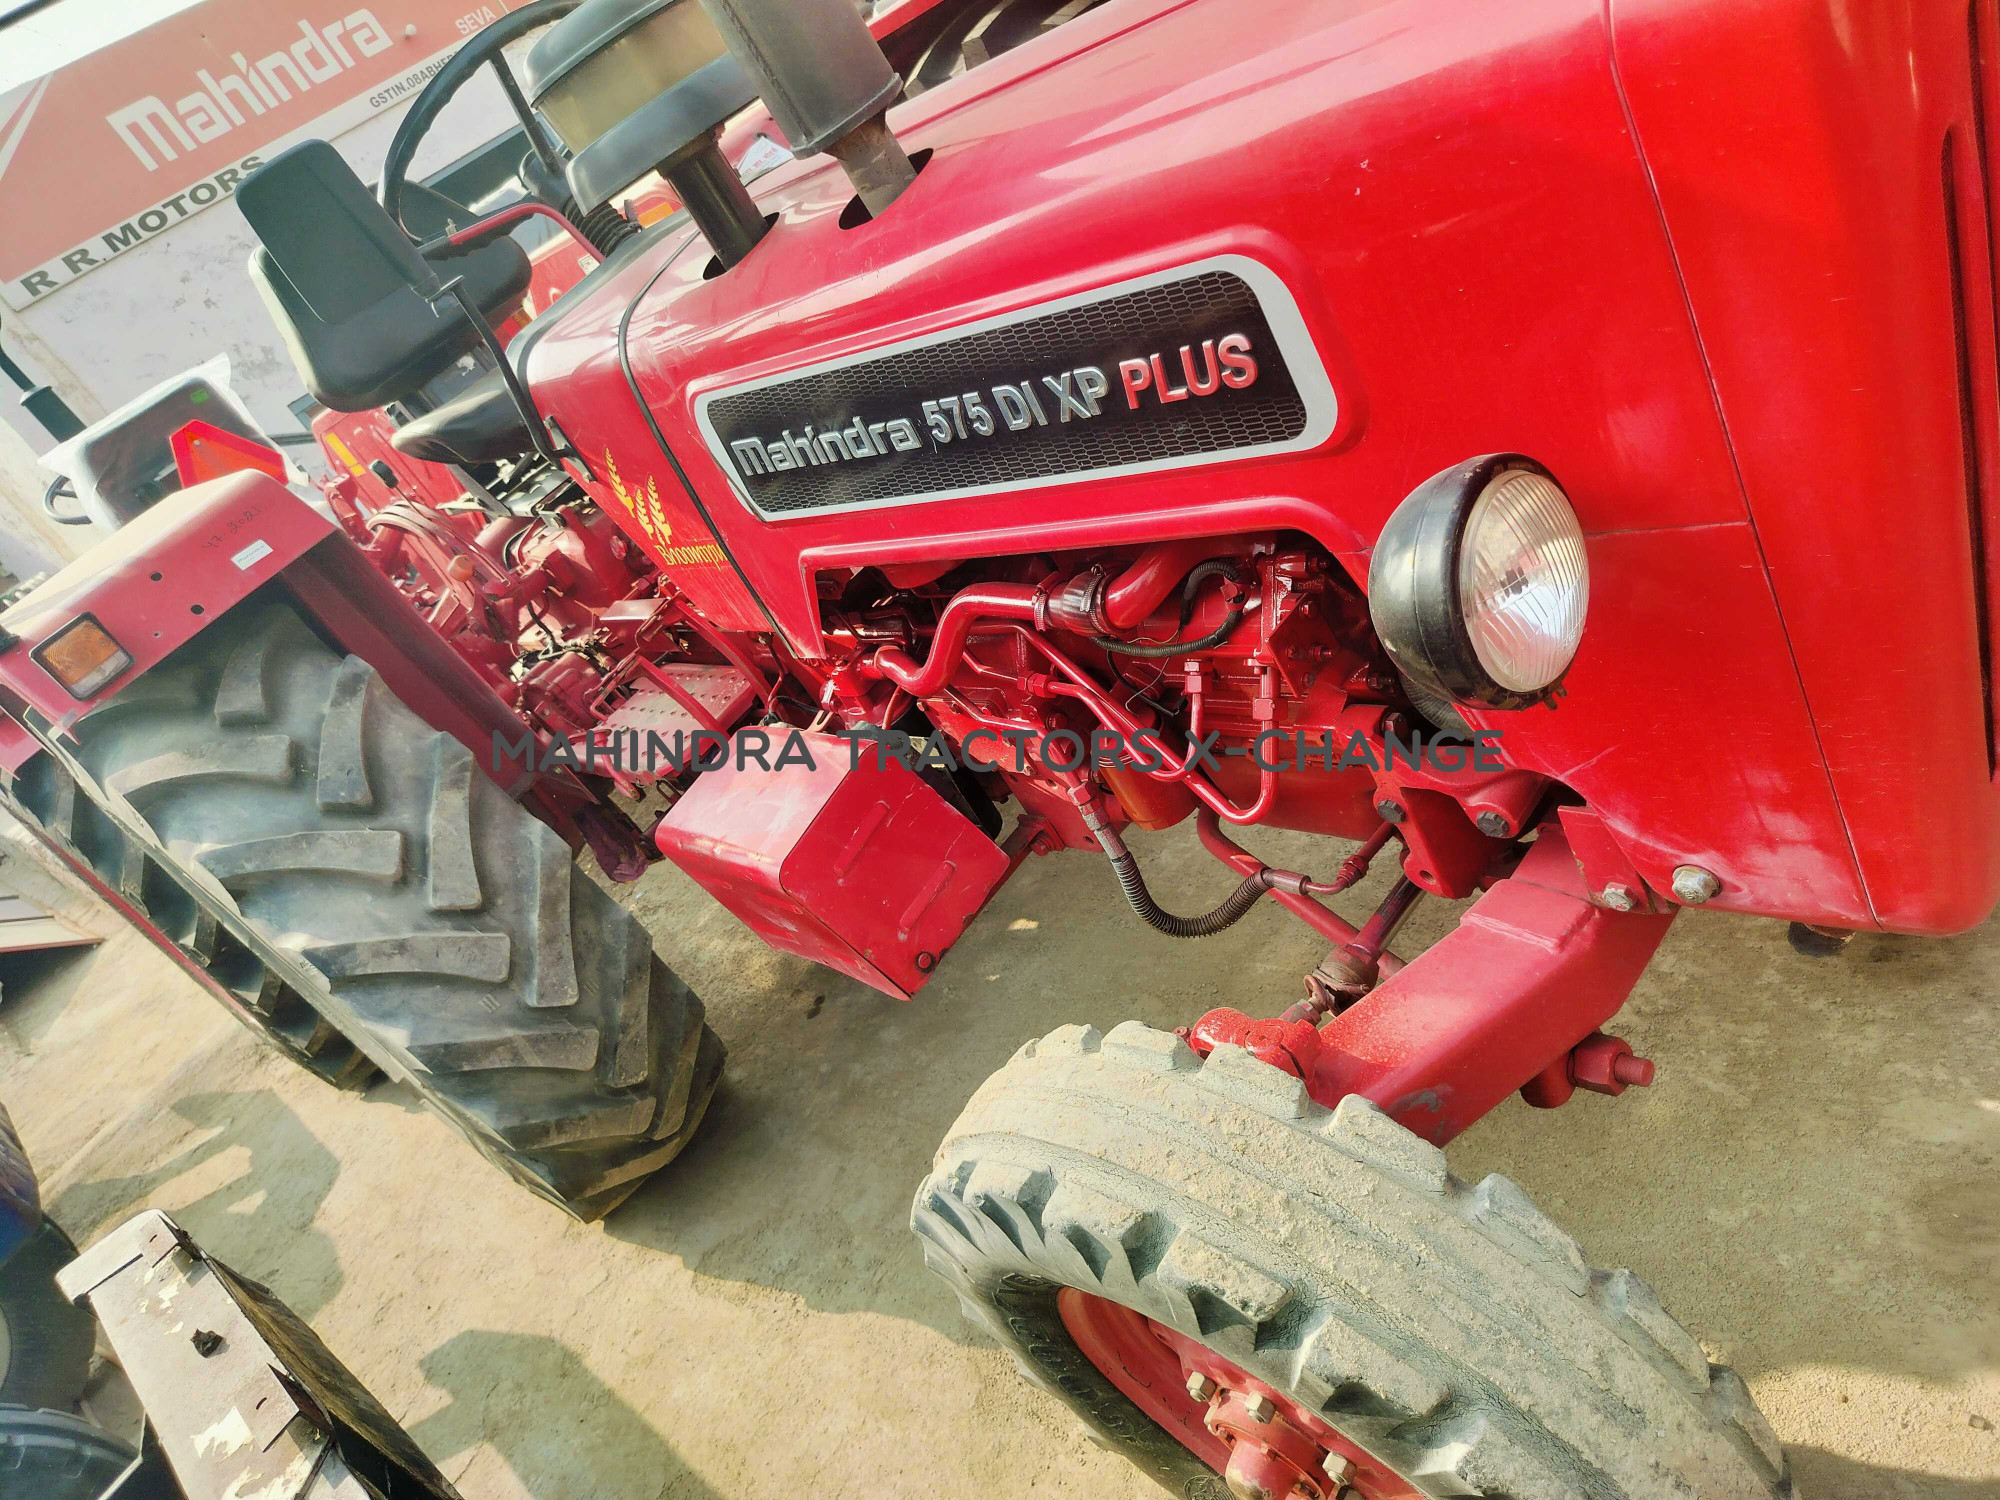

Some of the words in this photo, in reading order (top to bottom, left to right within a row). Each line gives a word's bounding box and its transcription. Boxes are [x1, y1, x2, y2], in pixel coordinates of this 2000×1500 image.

[455, 6, 496, 35] SEVA
[105, 8, 394, 172] Mahindra
[102, 156, 266, 254] MOTORS
[730, 416, 922, 476] Mahindra
[922, 391, 995, 444] 575
[992, 381, 1048, 431] DI
[1042, 366, 1110, 423] XP
[1118, 333, 1259, 410] PLUS
